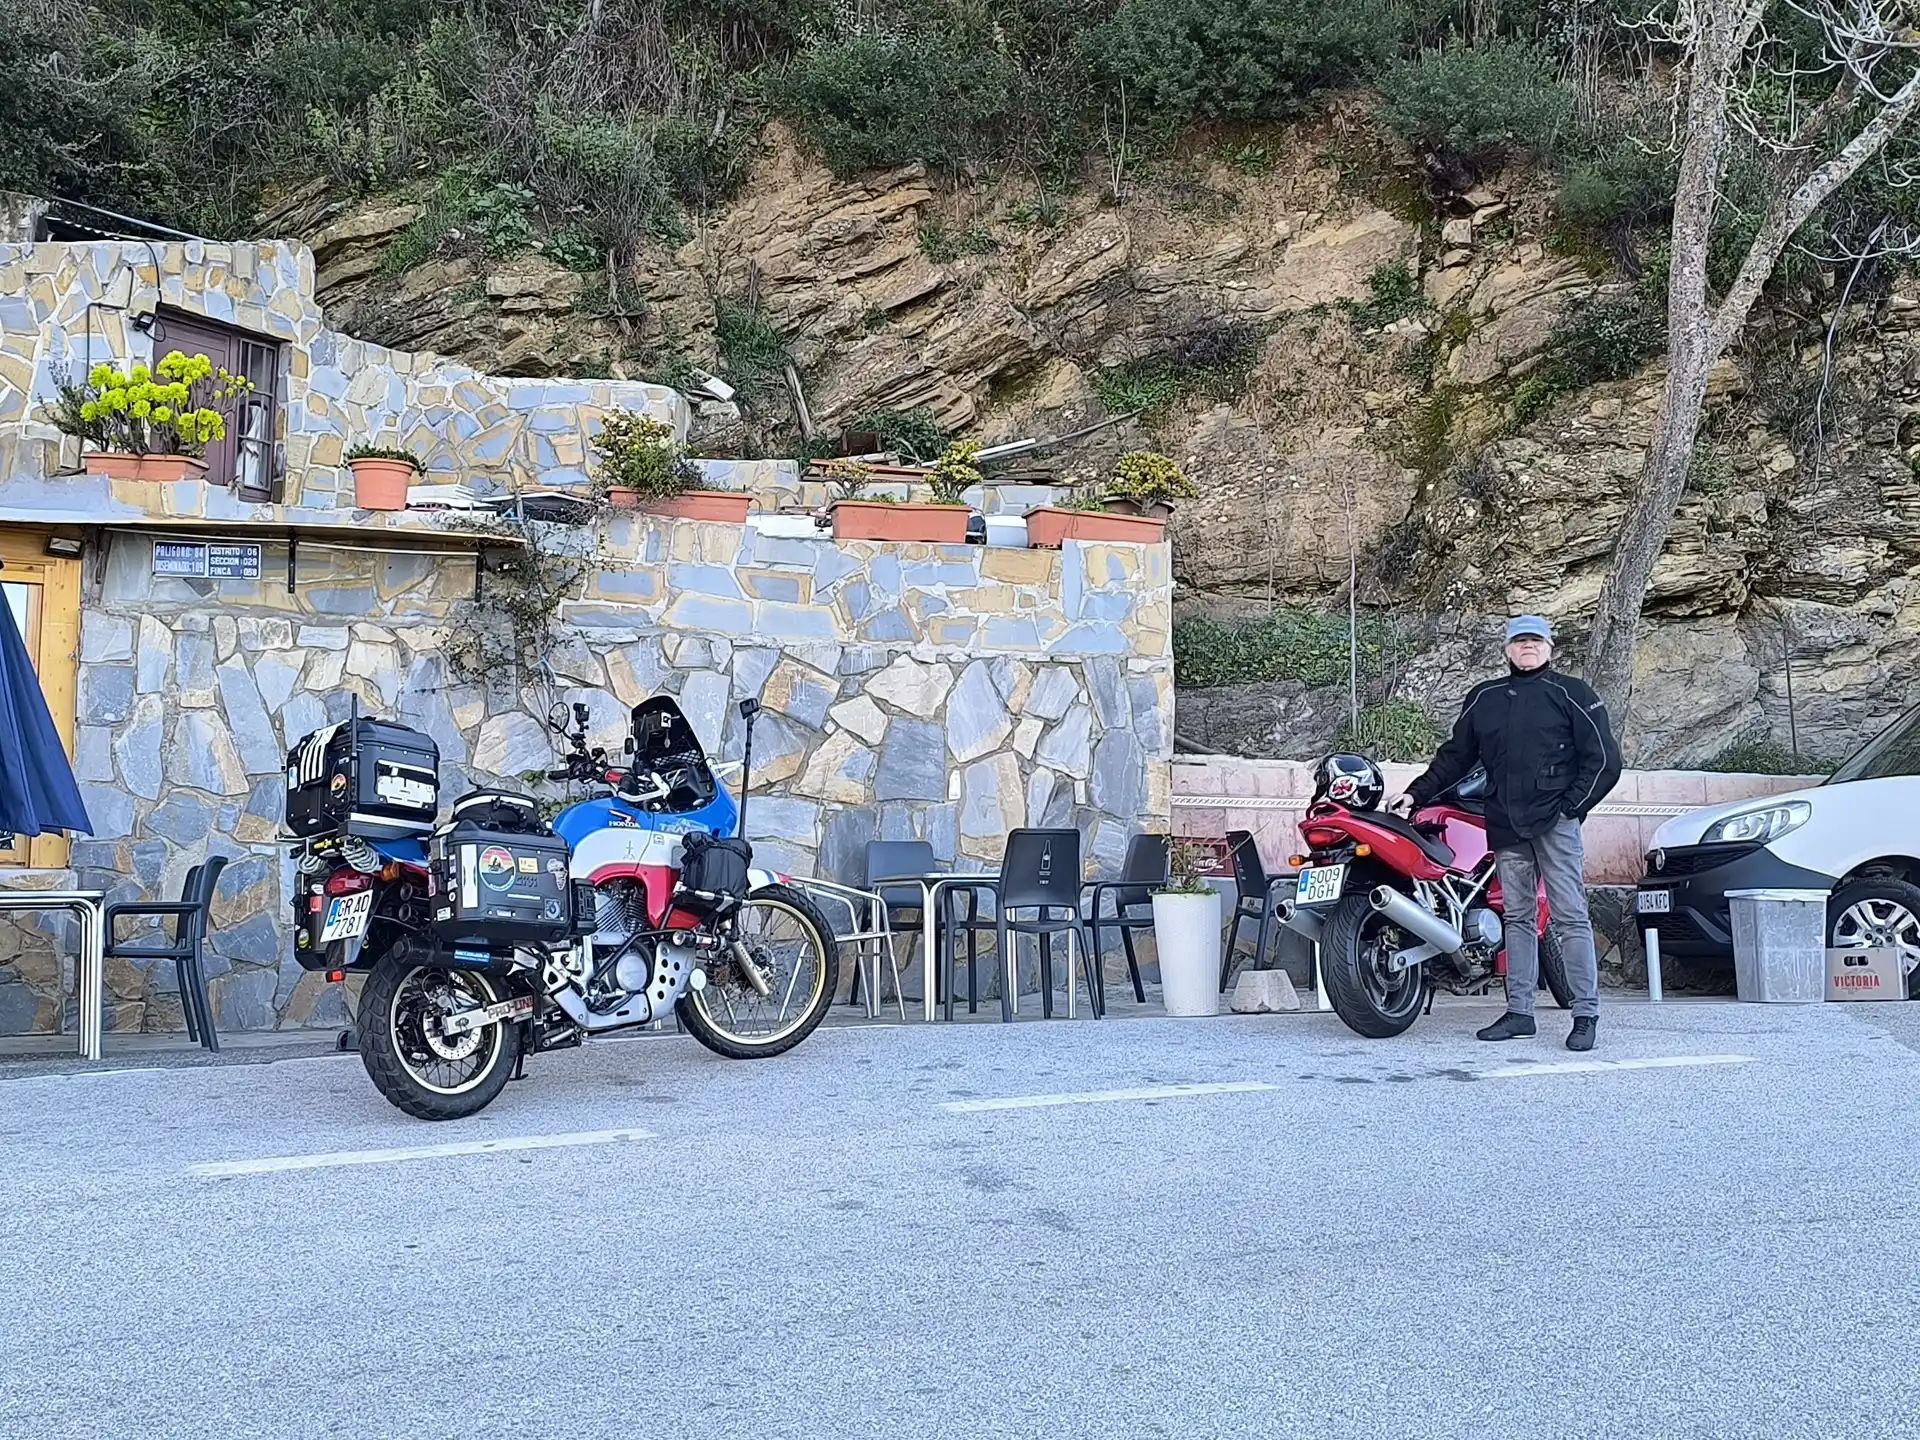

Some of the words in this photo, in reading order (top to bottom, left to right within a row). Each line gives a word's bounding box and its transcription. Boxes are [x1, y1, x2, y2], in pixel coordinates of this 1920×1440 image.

[247, 547, 257, 556] 06
[608, 820, 641, 828] HONDA
[1310, 867, 1340, 885] 5009
[1308, 883, 1335, 900] DGH
[338, 898, 354, 917] GR
[331, 916, 362, 938] 7781
[1833, 975, 1880, 987] VICTORIA
